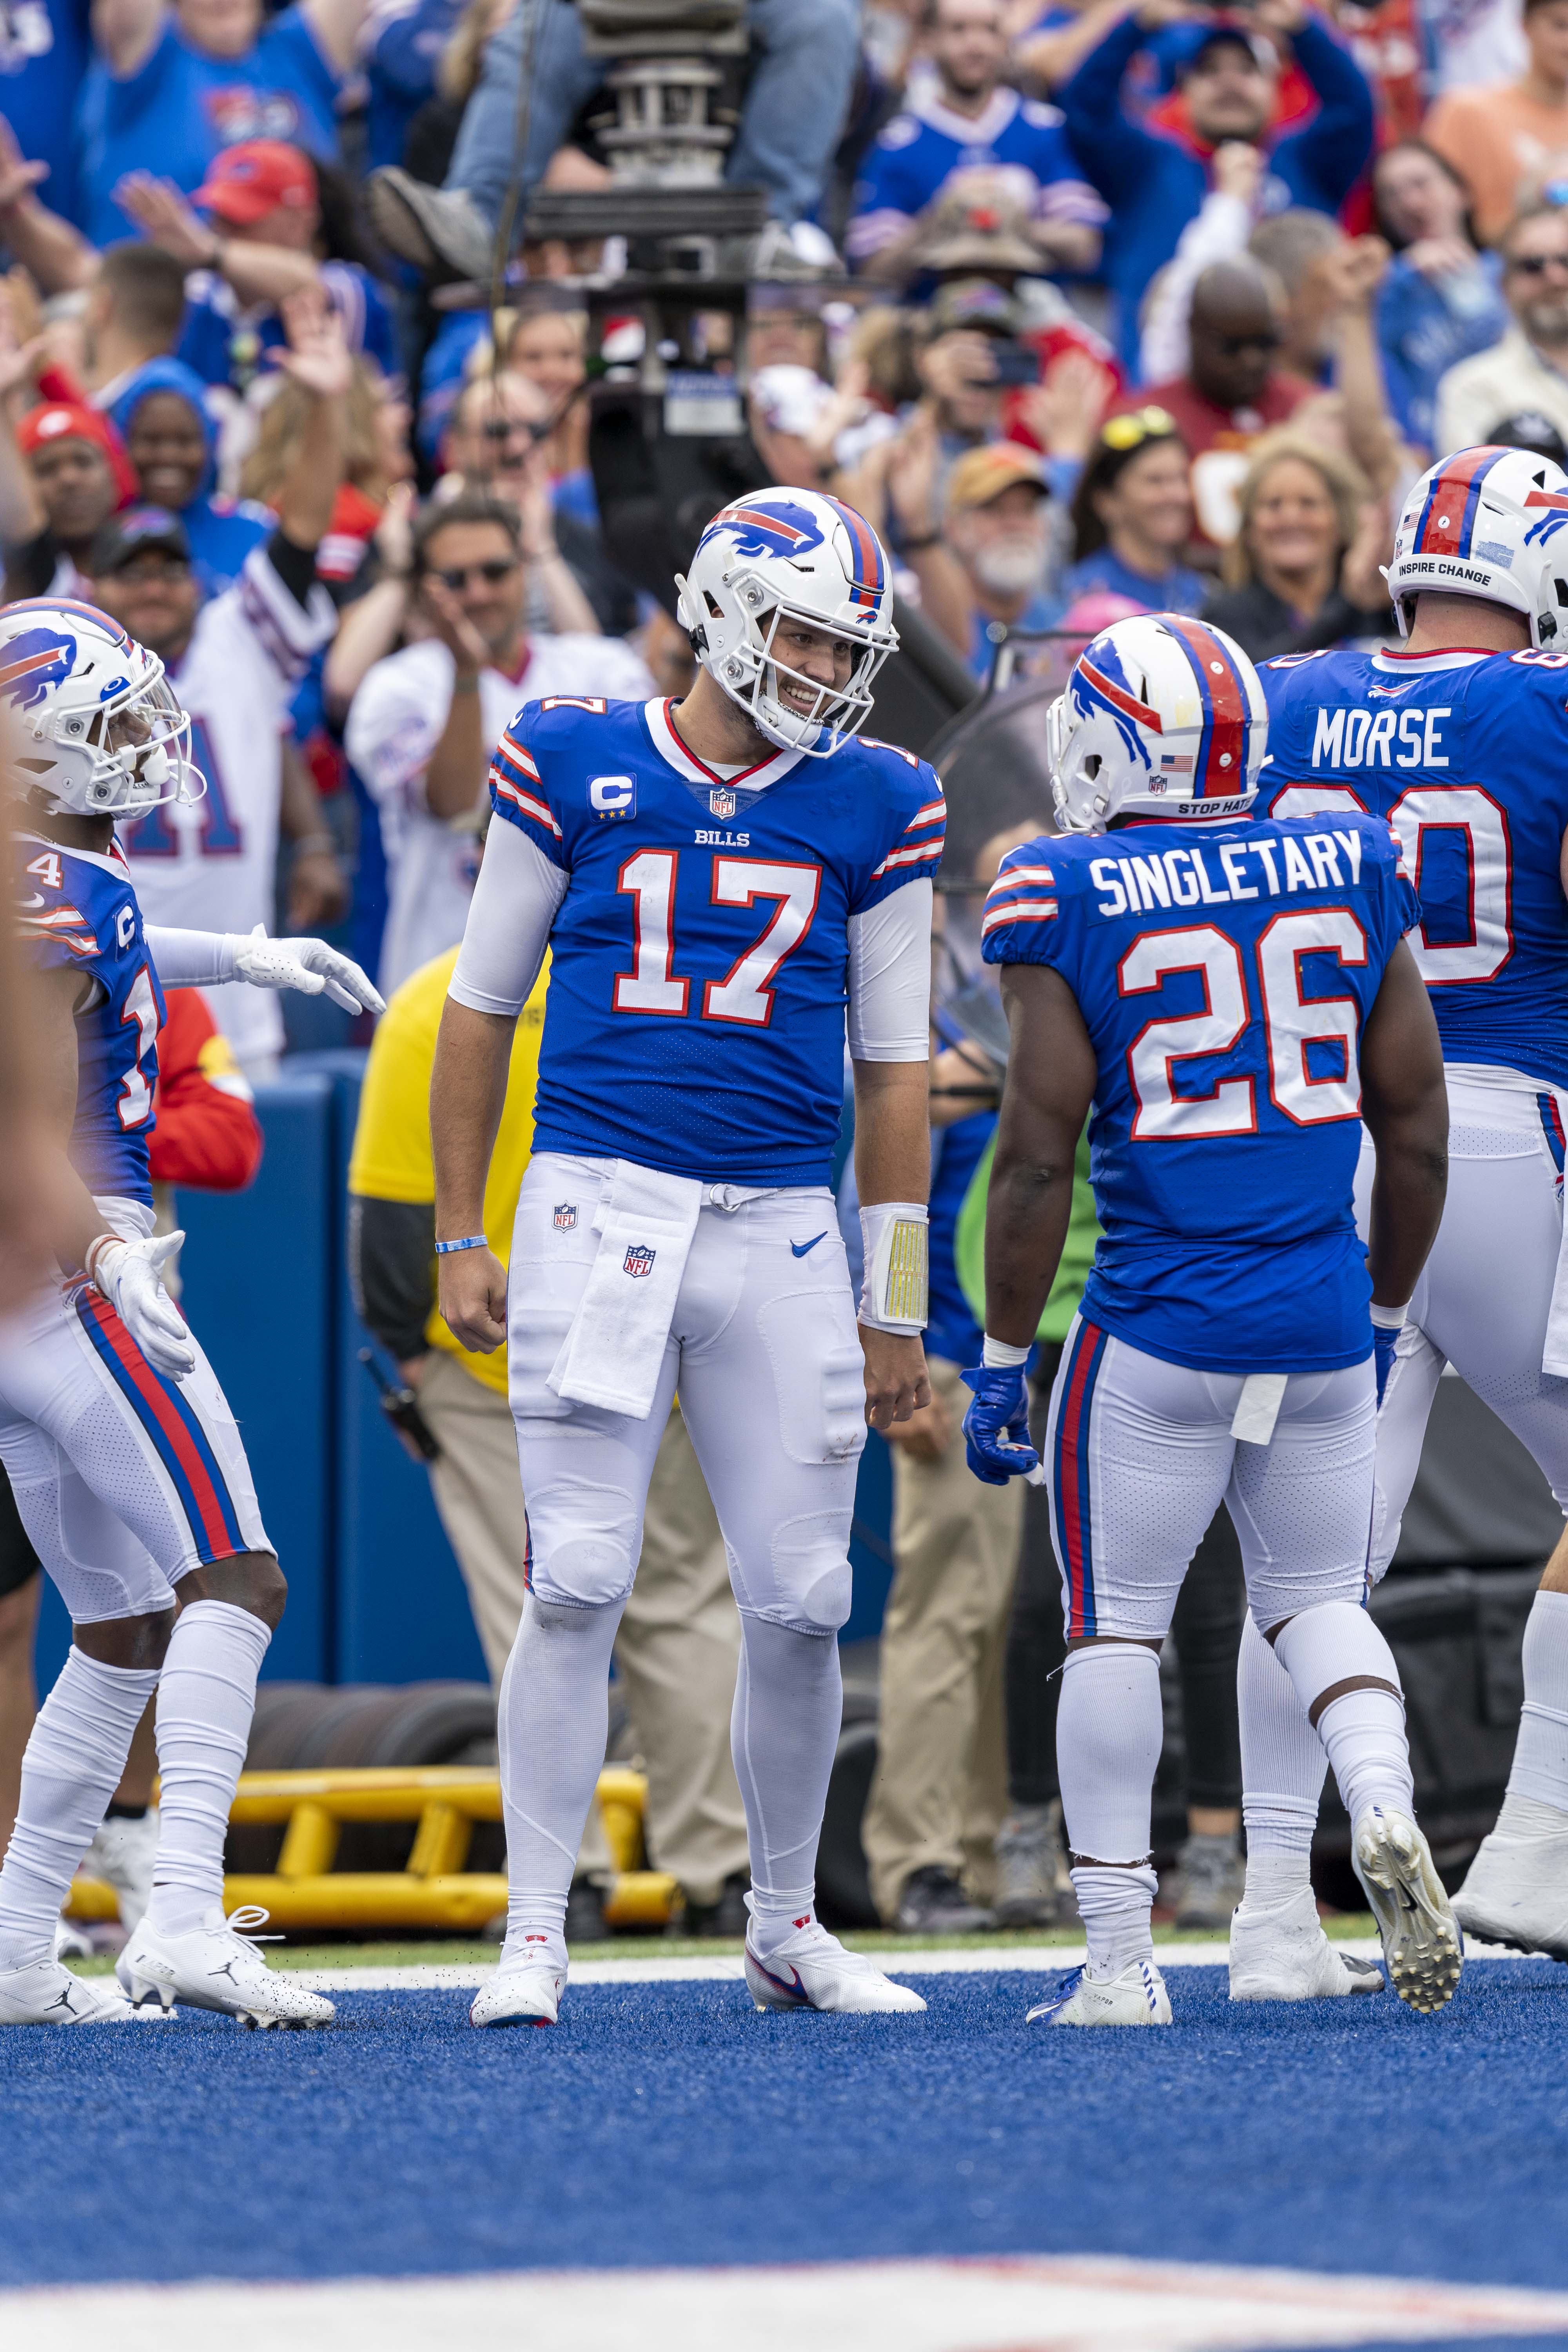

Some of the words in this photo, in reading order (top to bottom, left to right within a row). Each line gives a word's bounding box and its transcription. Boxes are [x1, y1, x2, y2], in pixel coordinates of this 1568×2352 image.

[1399, 562, 1436, 577] INSPIRE
[1439, 563, 1492, 586] CHANGE
[1312, 707, 1452, 768] MORSE
[590, 776, 633, 810] C
[1151, 782, 1164, 793] NFL
[714, 801, 731, 813] NFL
[1178, 803, 1220, 814] STOP
[694, 829, 750, 848] BILLS
[1089, 829, 1362, 917] SINGLETARY
[117, 906, 135, 947] C
[611, 846, 823, 1029] 17
[1116, 905, 1369, 1143] 26
[555, 1214, 573, 1227] NFL
[625, 1257, 649, 1275] NFL
